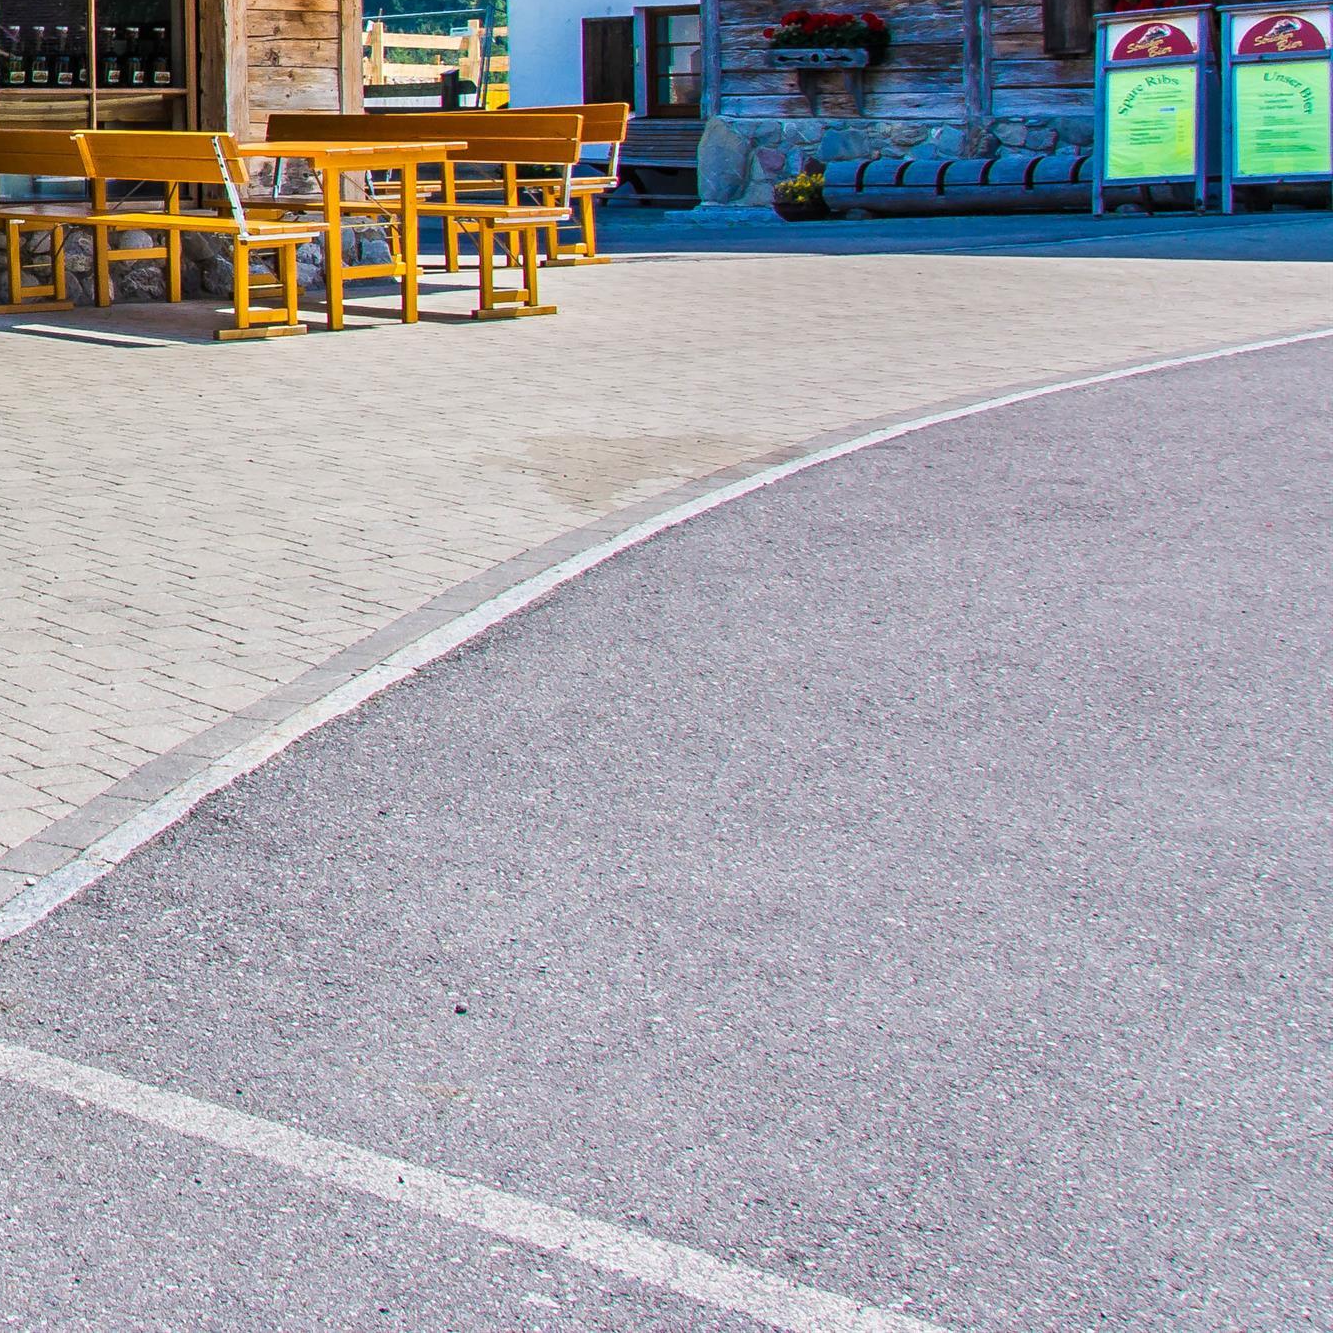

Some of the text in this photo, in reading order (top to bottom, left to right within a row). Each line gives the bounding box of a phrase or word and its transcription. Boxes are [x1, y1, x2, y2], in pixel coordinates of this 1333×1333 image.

[1118, 84, 1144, 115] Spare
[1144, 74, 1180, 86] Ribs
[1263, 71, 1303, 88] Unser
[1299, 87, 1315, 115] Bier
